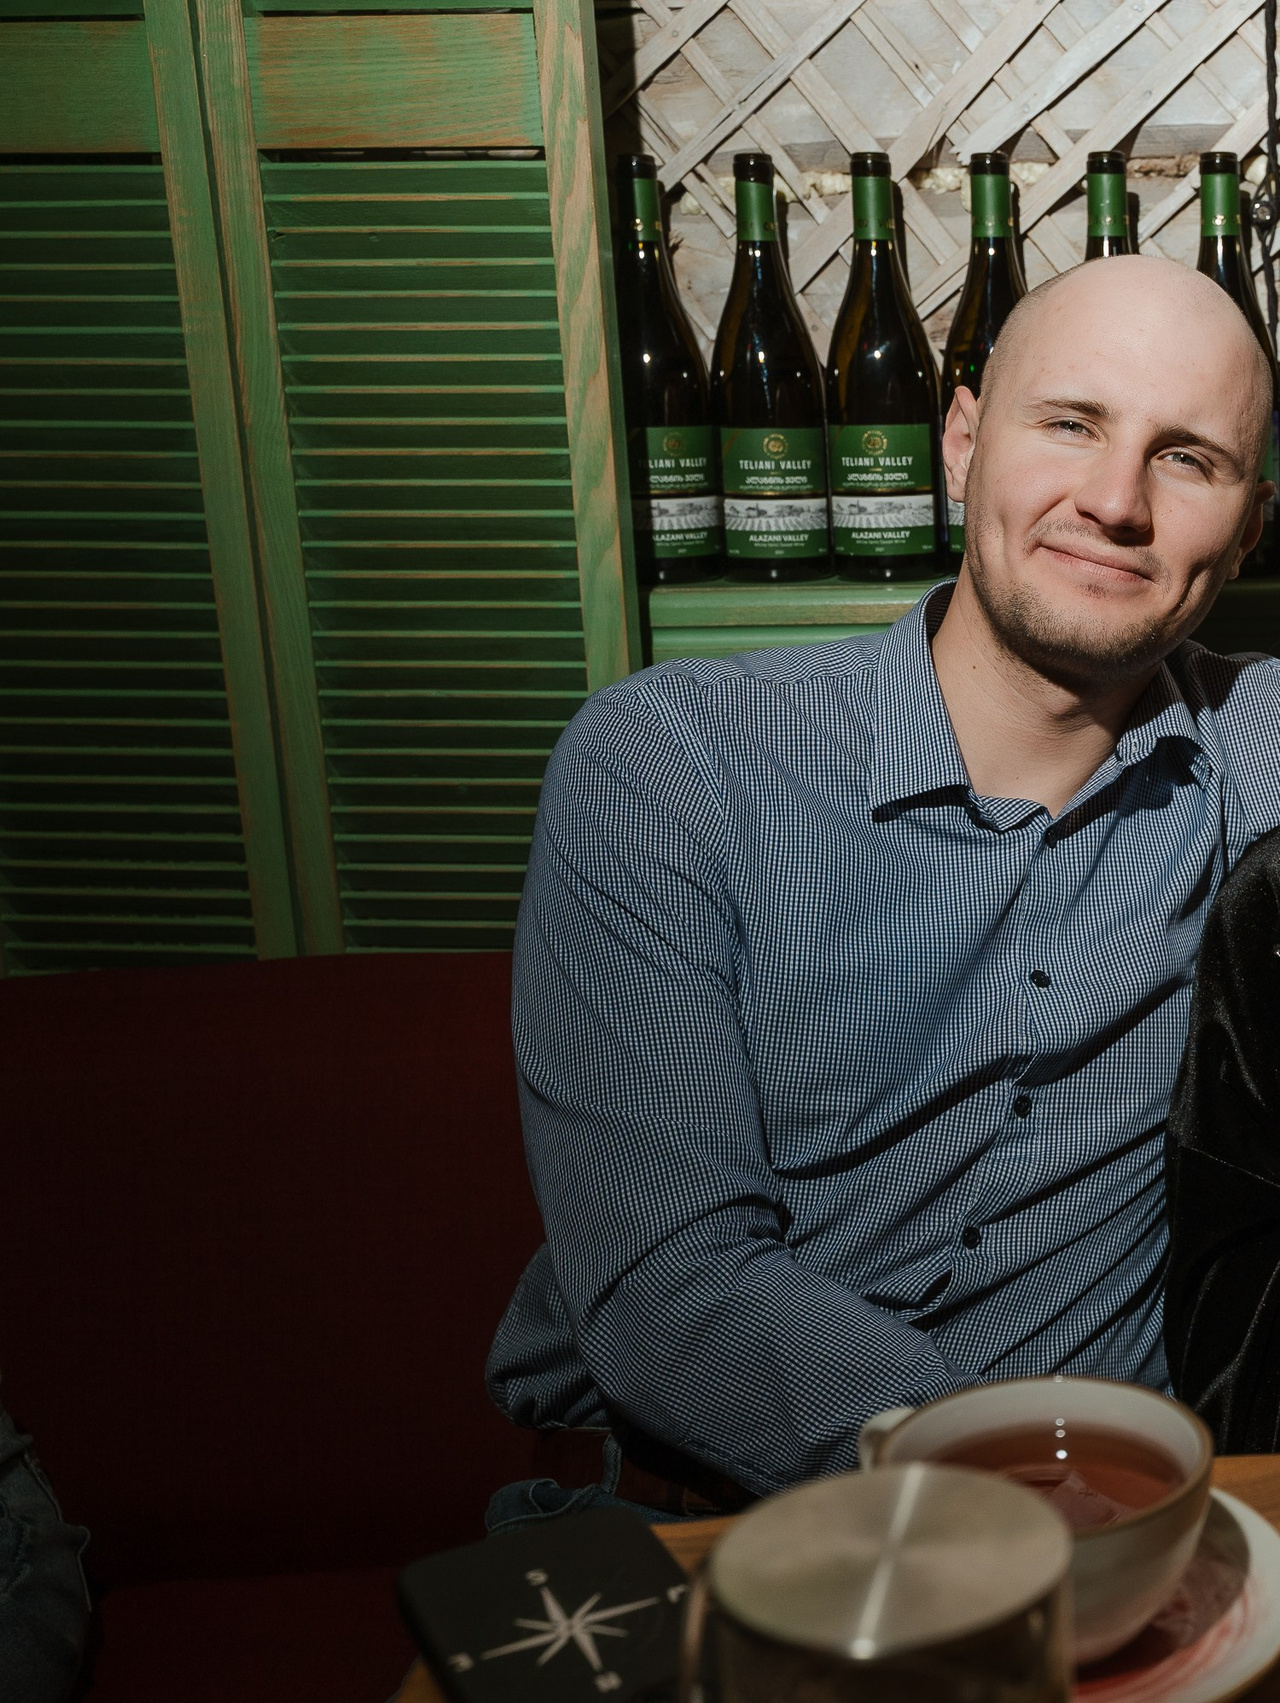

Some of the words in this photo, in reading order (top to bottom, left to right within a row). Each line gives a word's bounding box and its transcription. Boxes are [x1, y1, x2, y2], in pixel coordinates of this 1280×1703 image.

[640, 459, 675, 469] LIANI
[679, 457, 707, 468] VALLEY
[739, 459, 776, 470] TELIANI
[779, 459, 812, 470] VALLEY
[841, 456, 875, 467] TELIANI
[878, 456, 914, 466] VALLEY
[782, 533, 810, 542] VALLEY
[851, 531, 882, 539] ALAZANI
[882, 530, 911, 539] VALLEY
